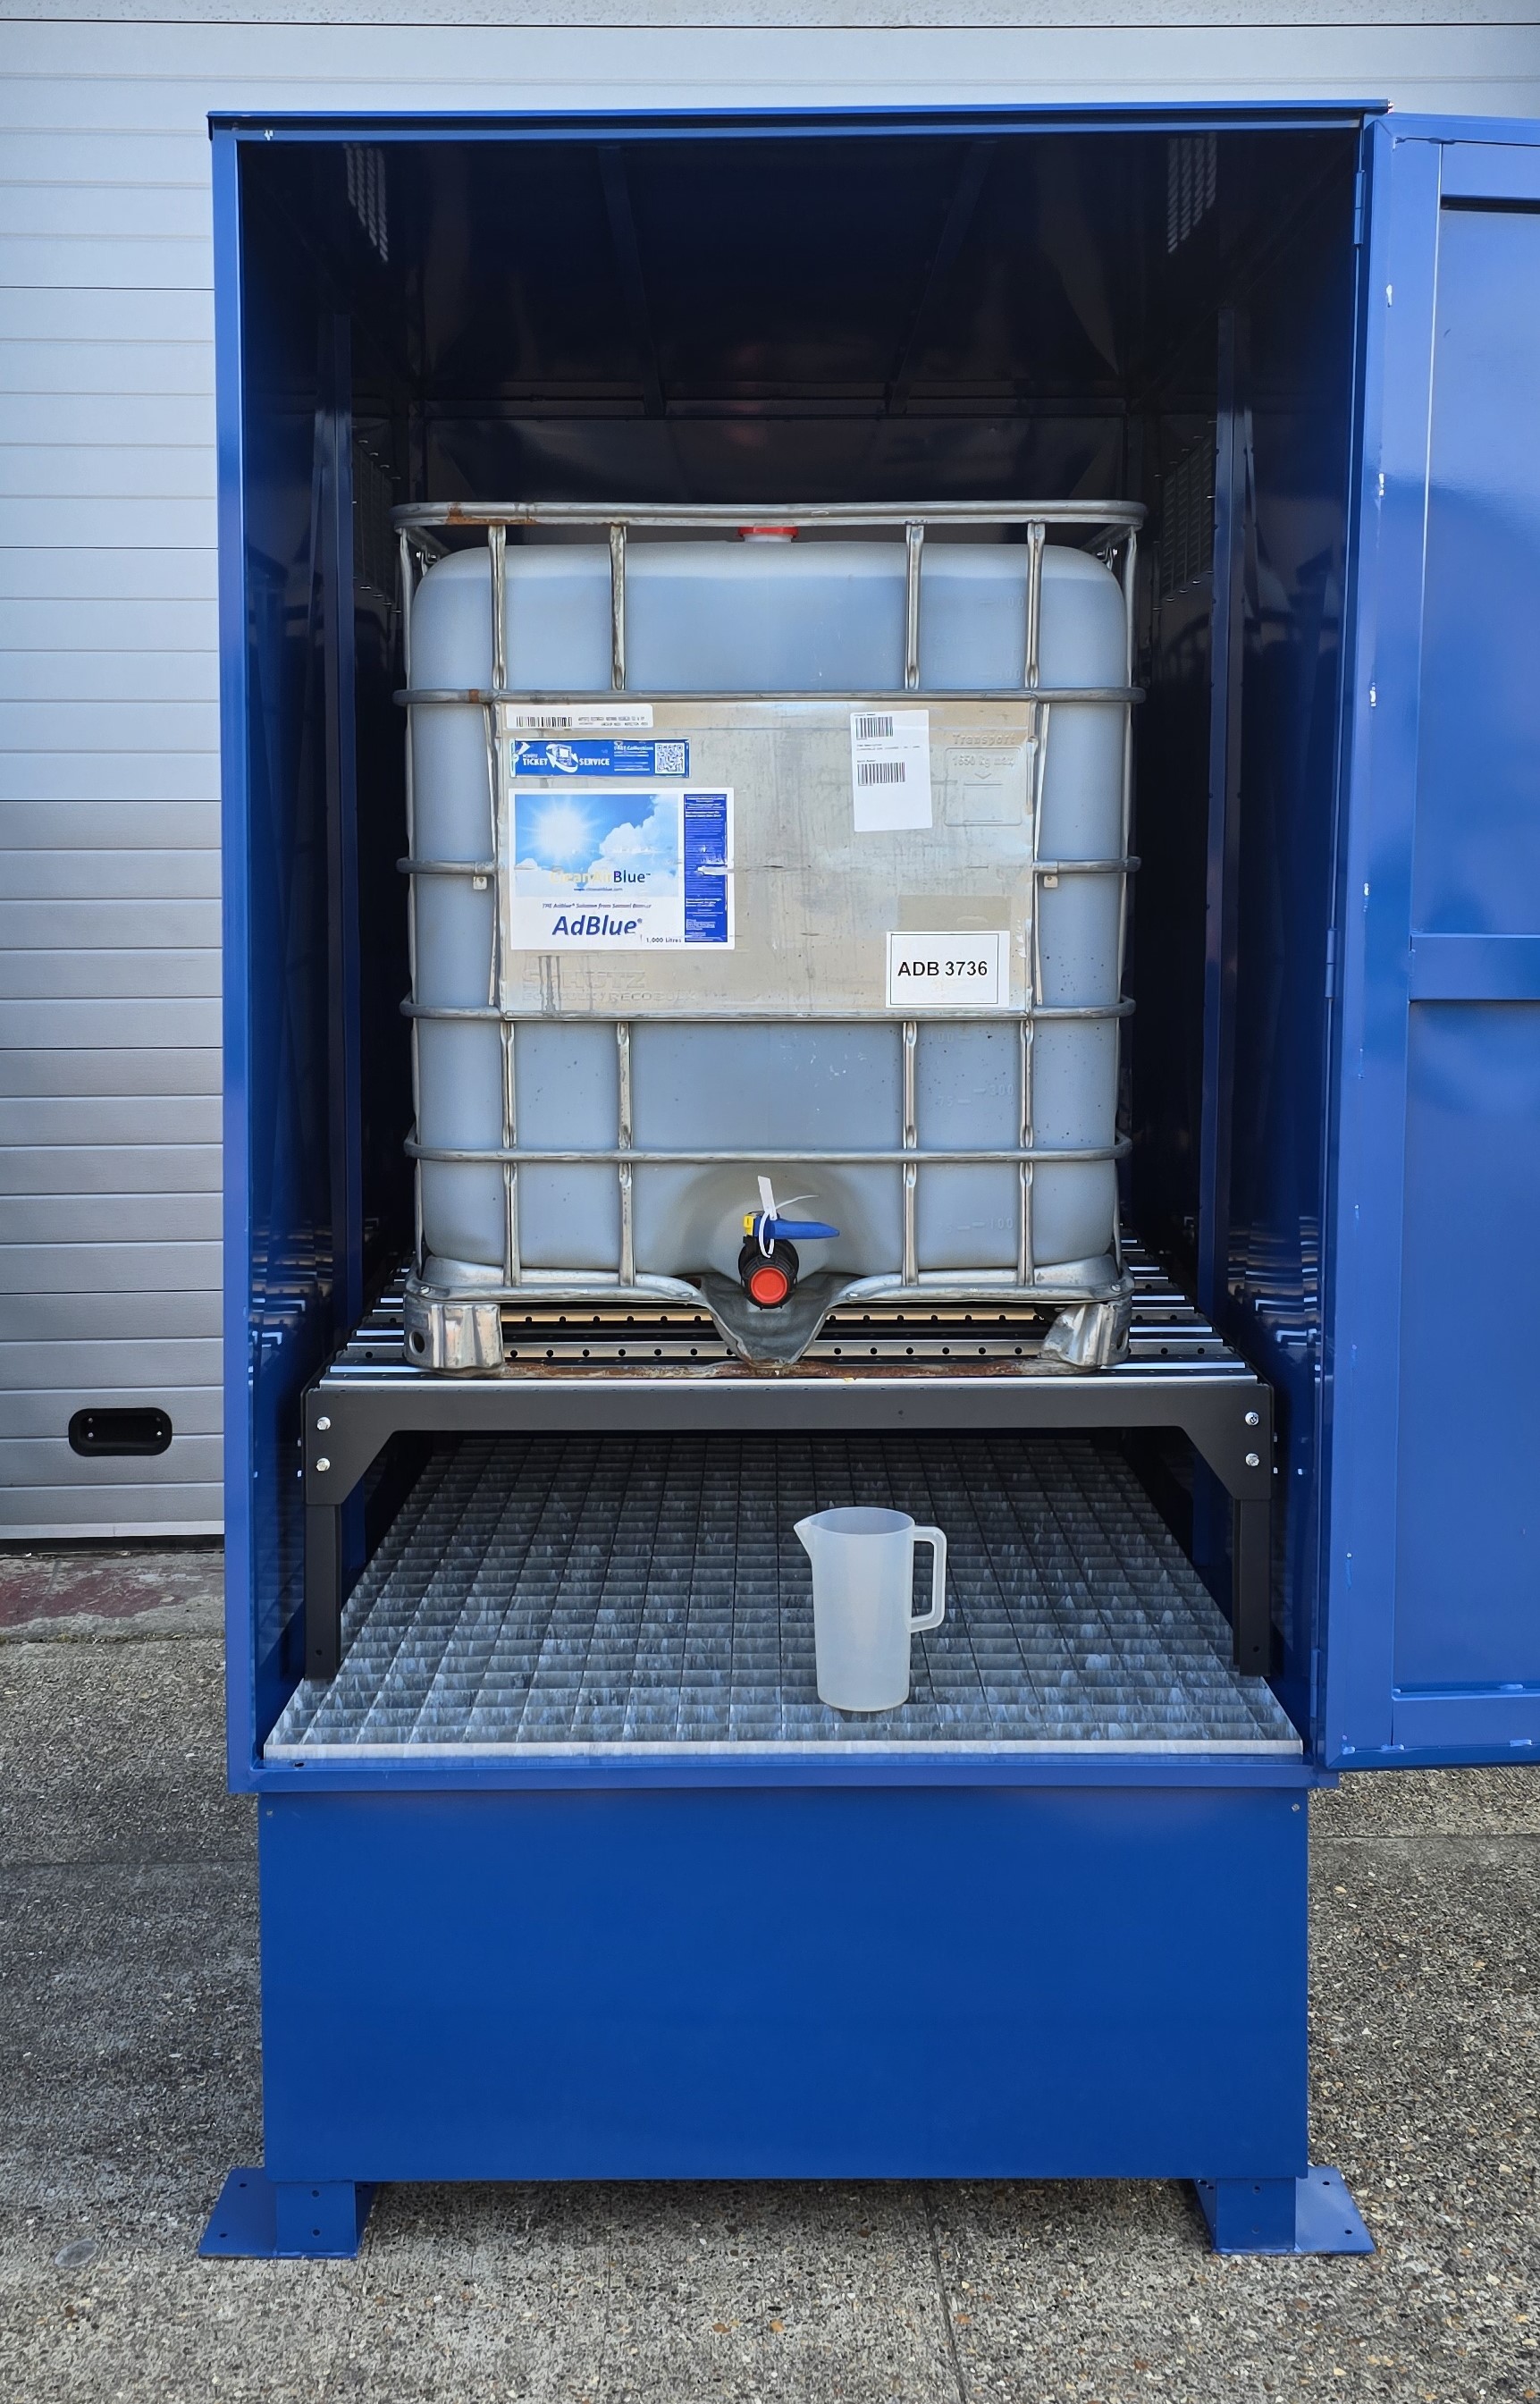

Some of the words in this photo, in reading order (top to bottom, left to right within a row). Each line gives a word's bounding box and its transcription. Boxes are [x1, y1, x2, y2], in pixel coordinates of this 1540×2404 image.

[952, 733, 1015, 746] Transport
[523, 758, 548, 766] TICKET
[579, 758, 610, 766] SERVICE
[897, 961, 939, 976] ADB
[945, 961, 988, 976] 3736
[989, 1217, 1013, 1229] 100
